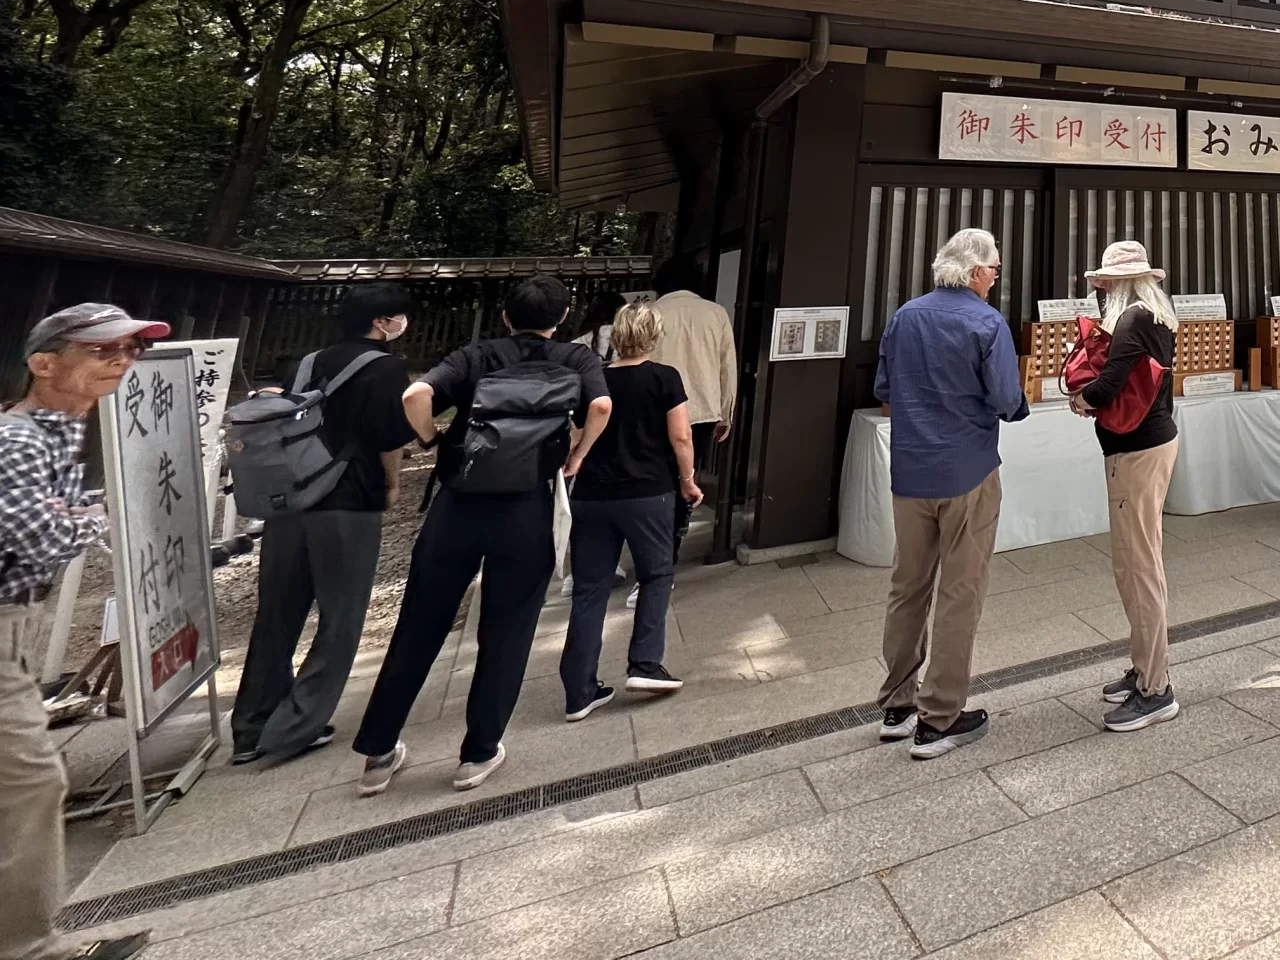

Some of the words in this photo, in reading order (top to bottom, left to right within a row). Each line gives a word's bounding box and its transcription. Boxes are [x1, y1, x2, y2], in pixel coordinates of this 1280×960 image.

[957, 109, 1167, 153] 御朱印受付
[157, 641, 183, 682] 入口
